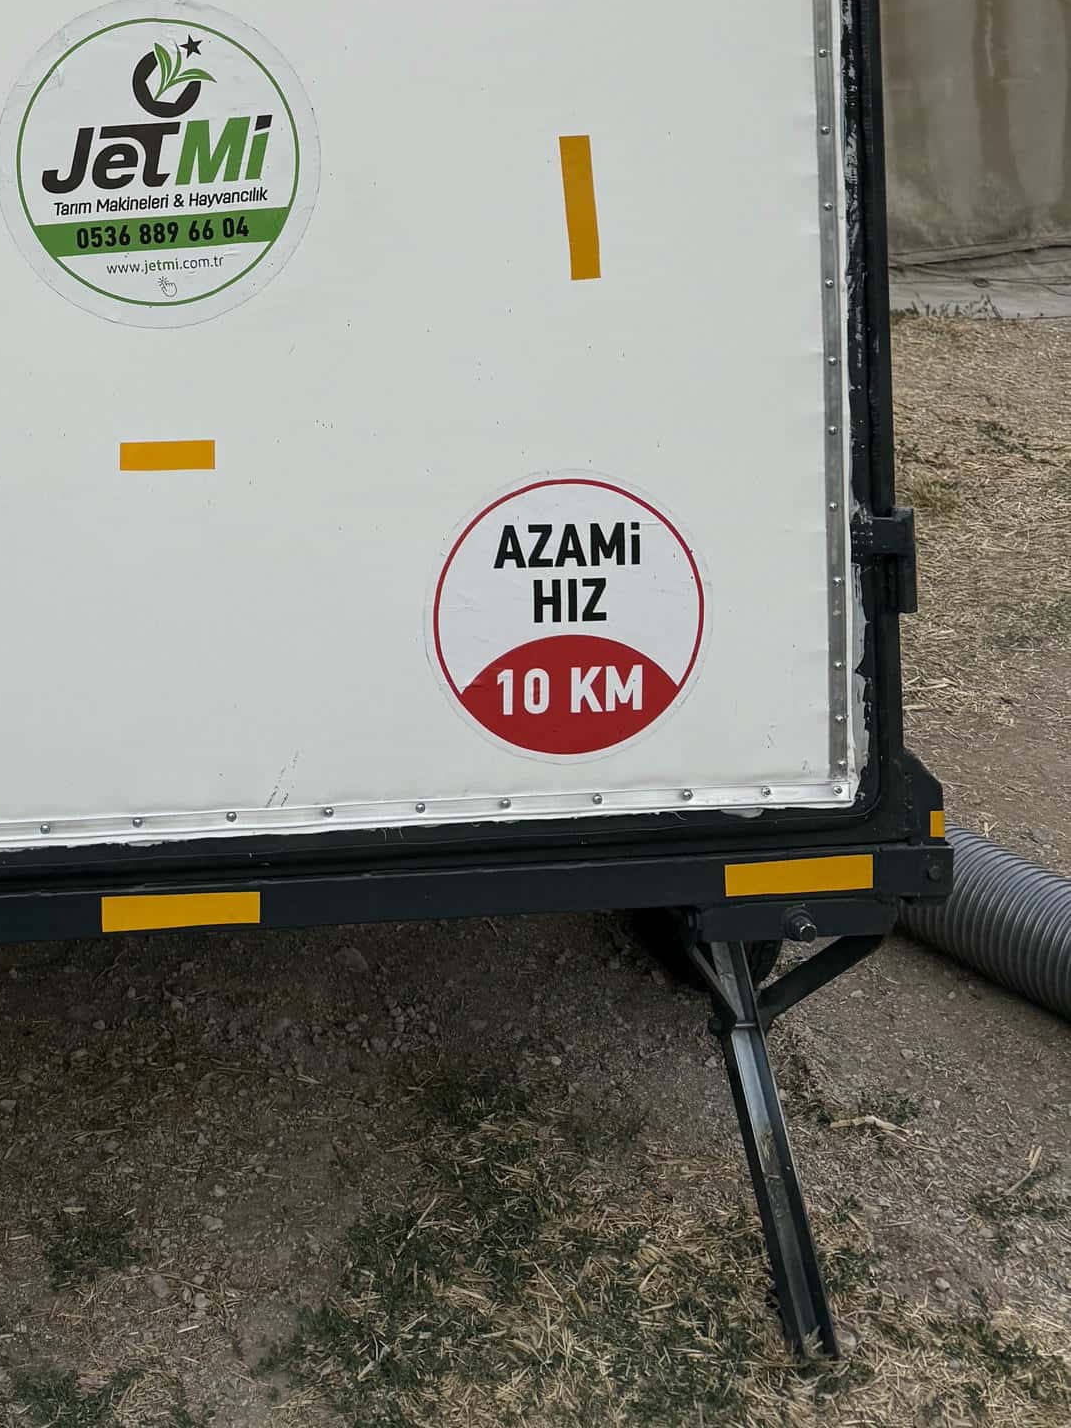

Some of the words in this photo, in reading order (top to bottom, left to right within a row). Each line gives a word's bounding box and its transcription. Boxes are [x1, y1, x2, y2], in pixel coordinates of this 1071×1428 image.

[54, 201, 92, 216] Tarım
[96, 193, 169, 213] Makineleri
[173, 193, 184, 208] &
[189, 186, 268, 209] Hayvancılık
[77, 225, 130, 249] 0536
[139, 221, 179, 245] 889
[188, 219, 214, 241] 66
[223, 216, 249, 238] 04
[106, 254, 225, 275] www.jetmi.com.tr
[533, 578, 607, 623] HIZ
[497, 668, 549, 716] 10
[570, 664, 643, 713] KM
